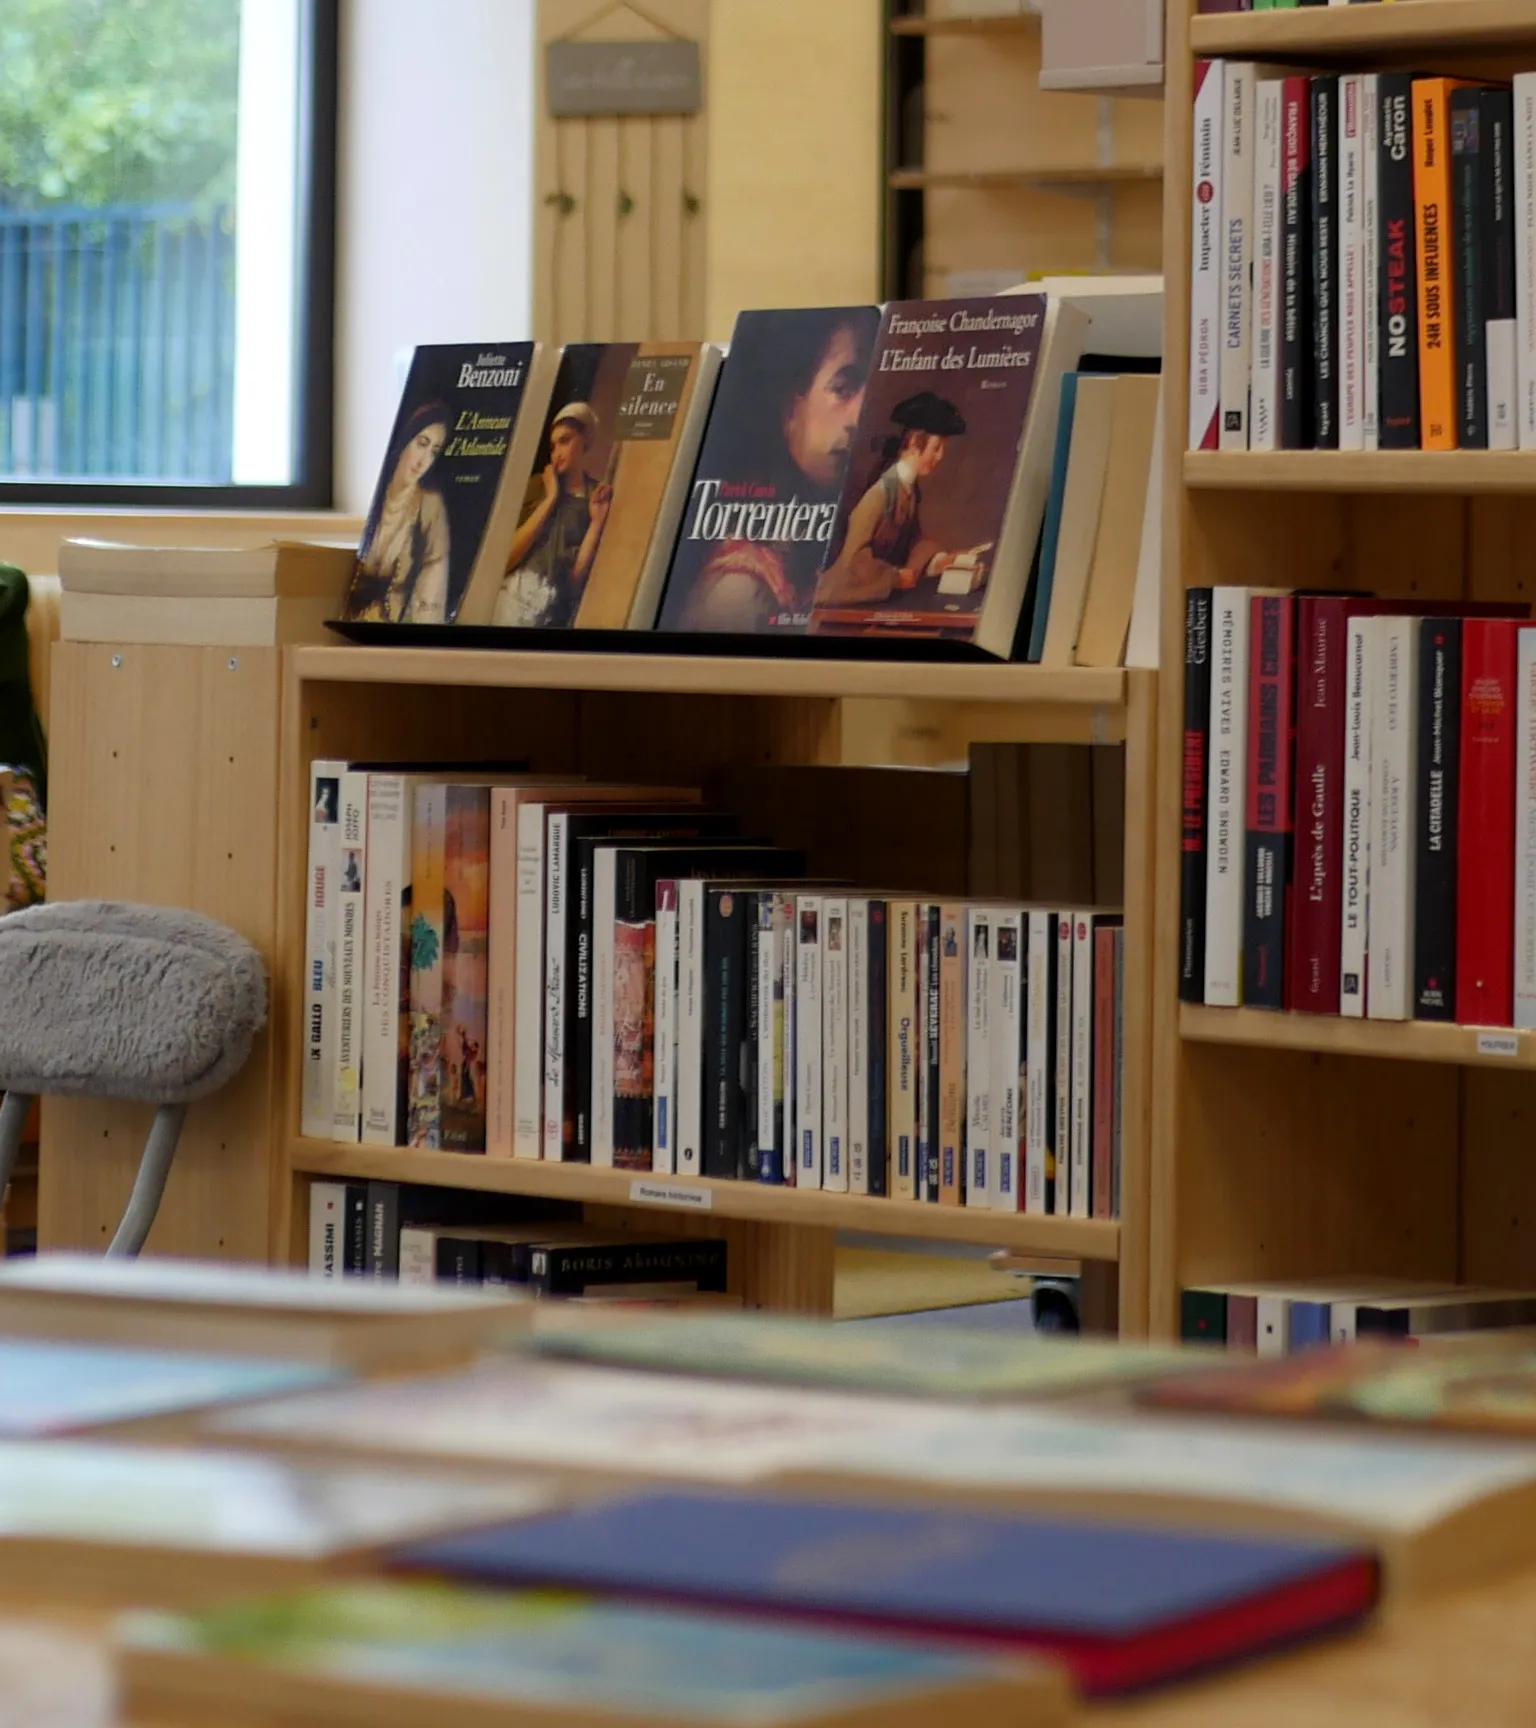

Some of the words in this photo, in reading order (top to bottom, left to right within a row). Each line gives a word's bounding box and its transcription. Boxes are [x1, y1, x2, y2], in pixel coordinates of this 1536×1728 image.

[1390, 95, 1407, 160] Caron
[1228, 218, 1243, 280] SECRETS
[1423, 203, 1440, 282] INFLUENCES
[1227, 284, 1242, 348] CARNETS
[1425, 285, 1440, 319] SOUS
[888, 314, 946, 337] Françoise
[949, 308, 1038, 338] Chandernagor
[1425, 324, 1442, 349] 24H
[459, 363, 520, 389] Benzoni
[880, 348, 938, 375] L'Enfant
[941, 350, 965, 370] des
[967, 345, 1031, 370] Lumières
[642, 372, 665, 393] En
[619, 395, 678, 418] silence
[687, 479, 835, 544] Torrentera
[1310, 764, 1326, 816] Gaulle
[1310, 821, 1325, 841] de
[314, 865, 326, 909] ROUGE
[1309, 844, 1326, 902] L'après
[312, 959, 324, 992] BLEU
[310, 1003, 322, 1043] GALLO
